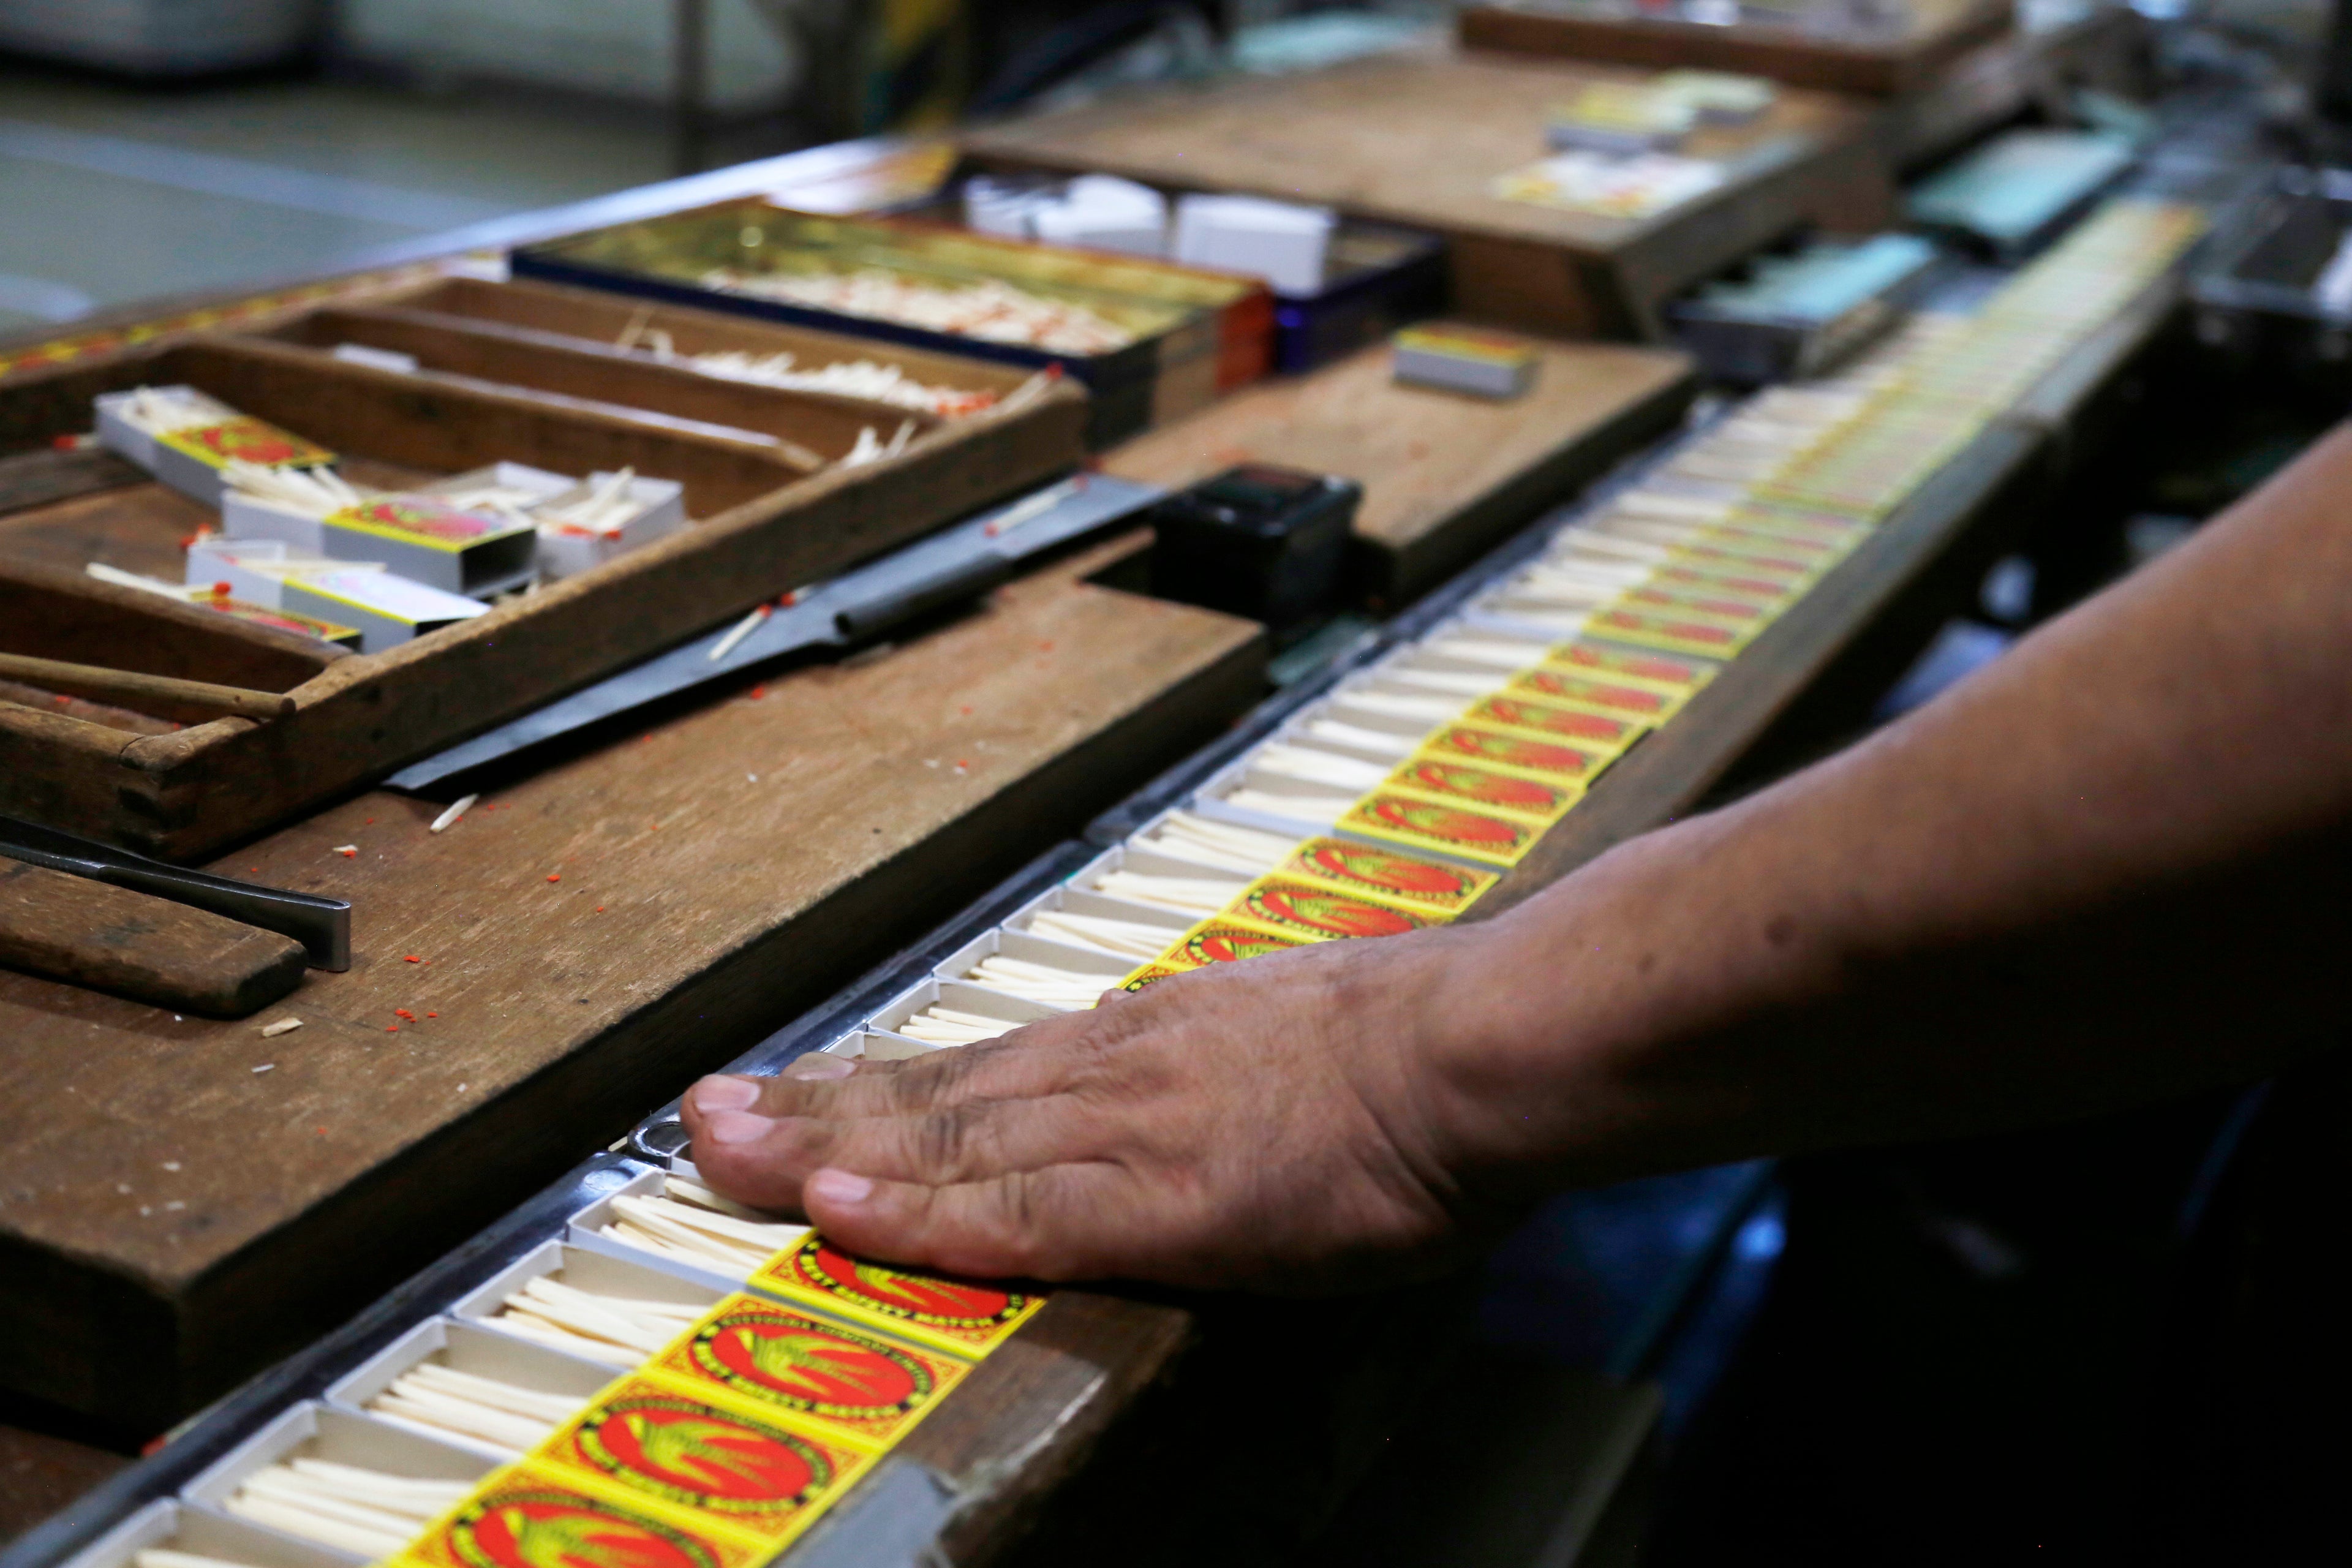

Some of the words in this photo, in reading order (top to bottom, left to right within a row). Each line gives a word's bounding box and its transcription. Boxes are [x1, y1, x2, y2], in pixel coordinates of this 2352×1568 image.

[799, 1254, 837, 1287] BEST
[834, 1286, 911, 1317] SAFETY
[913, 1311, 995, 1329] MATCH
